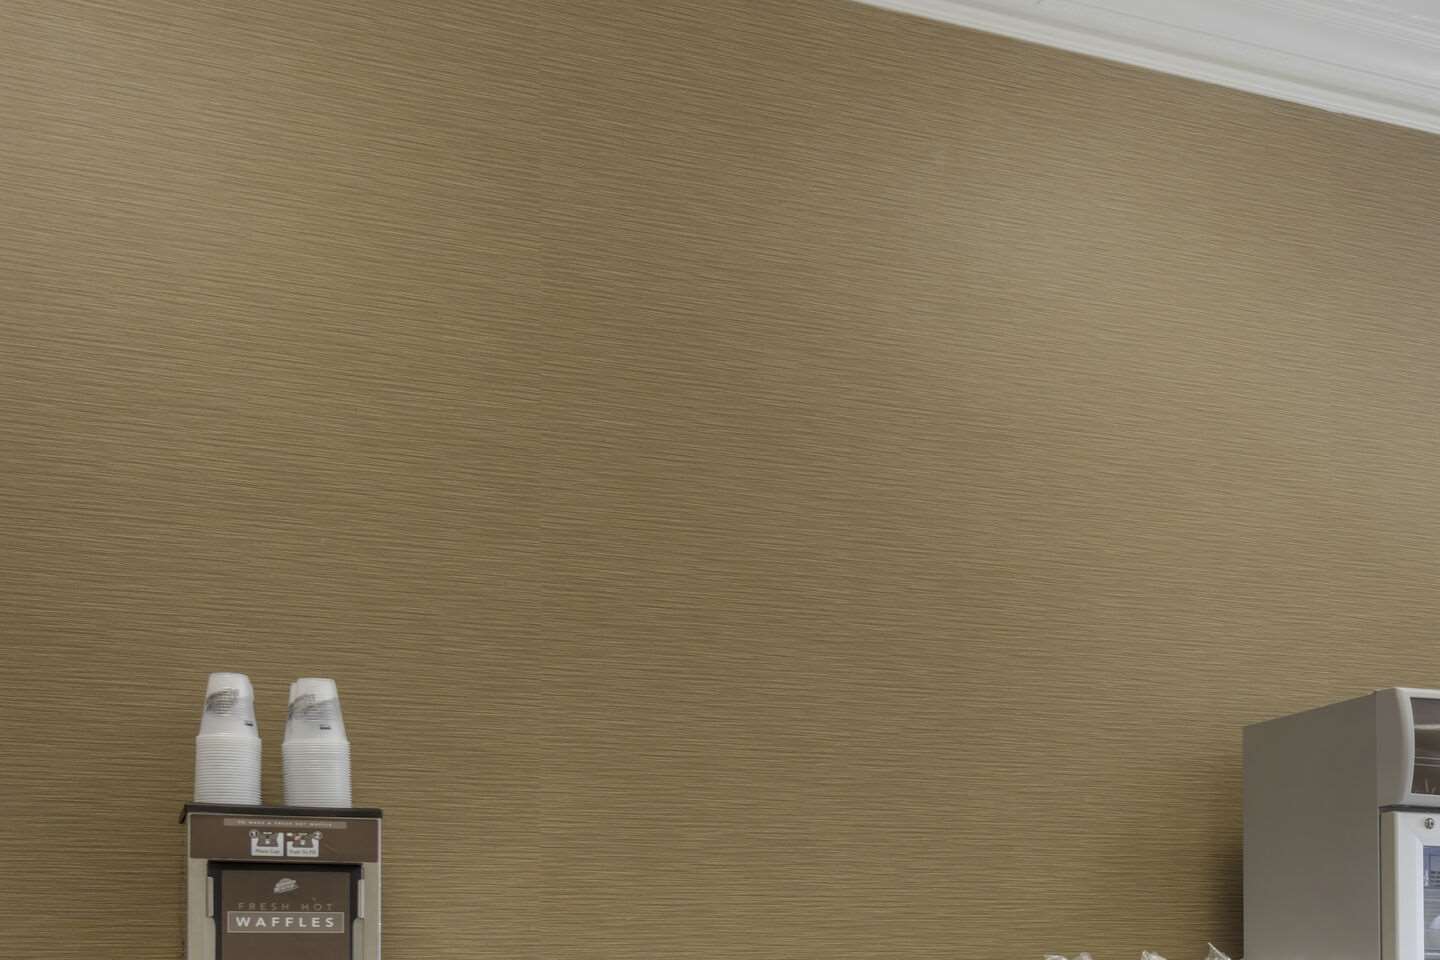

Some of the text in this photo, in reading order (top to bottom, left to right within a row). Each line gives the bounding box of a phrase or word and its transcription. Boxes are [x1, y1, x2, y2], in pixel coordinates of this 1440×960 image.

[238, 902, 334, 912] FRESH HOT
[235, 916, 337, 928] WAFFLES
